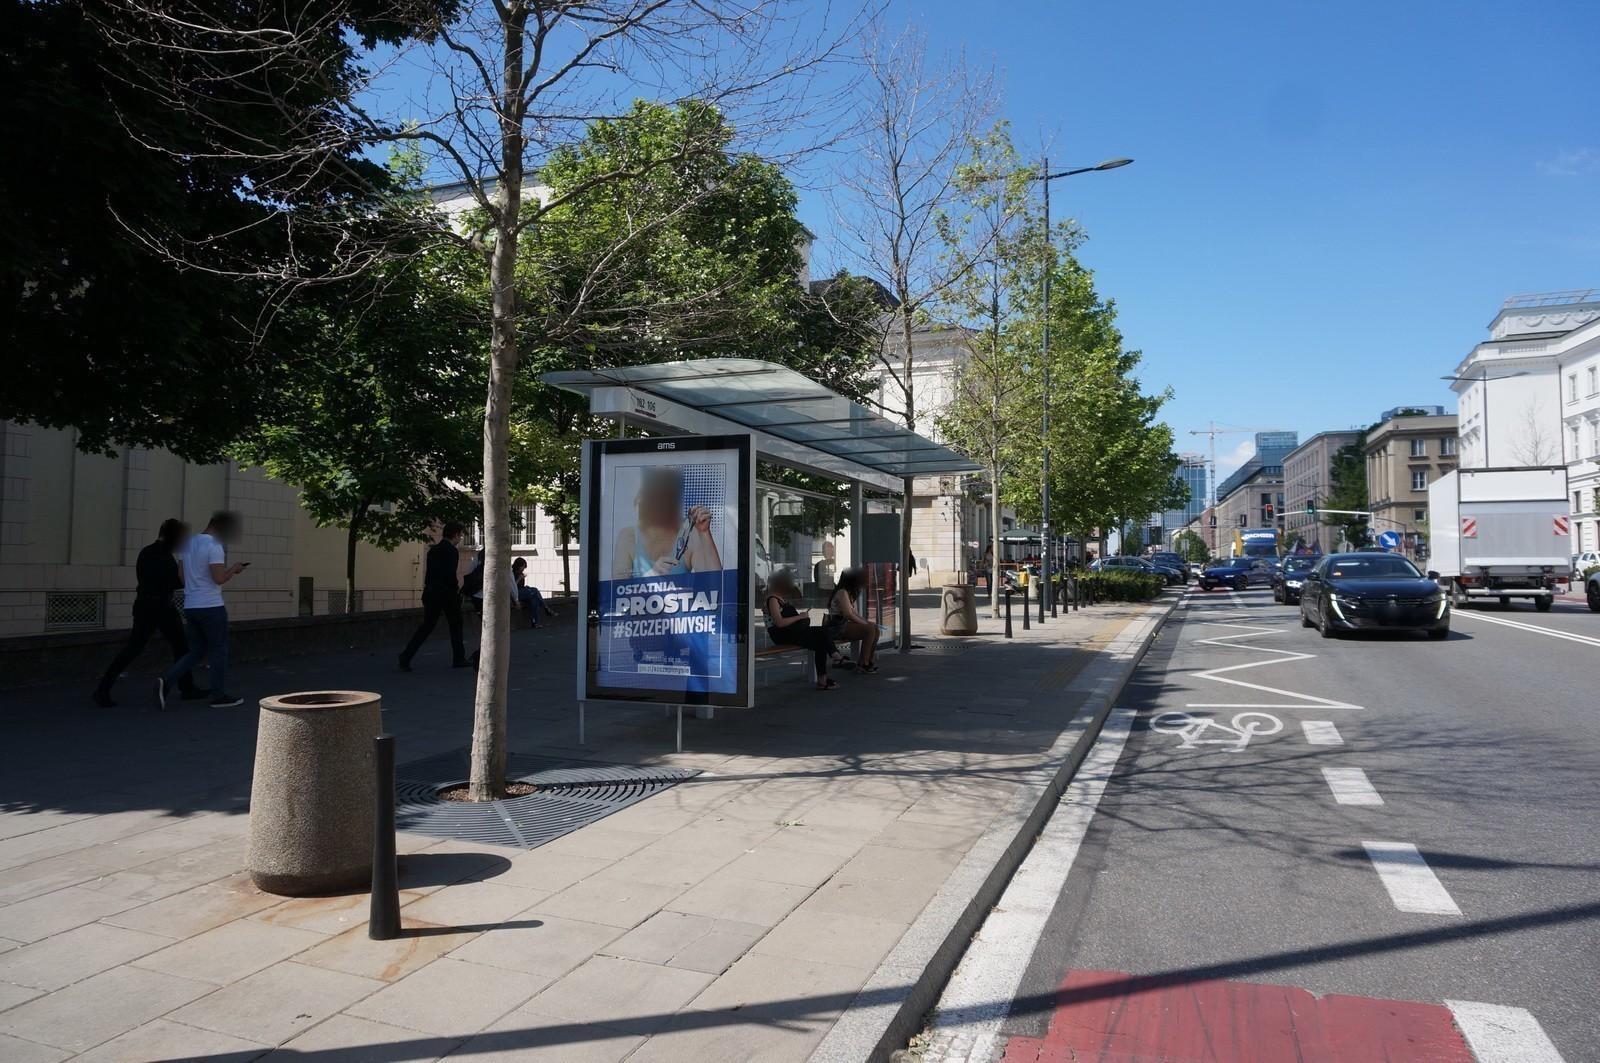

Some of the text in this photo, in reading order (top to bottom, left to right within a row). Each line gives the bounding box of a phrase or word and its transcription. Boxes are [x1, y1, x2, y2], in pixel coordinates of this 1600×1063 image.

[657, 442, 676, 450] ams
[615, 590, 719, 616] PROSTA!
[613, 614, 717, 639] #SZCZEPIMYSIĘ
